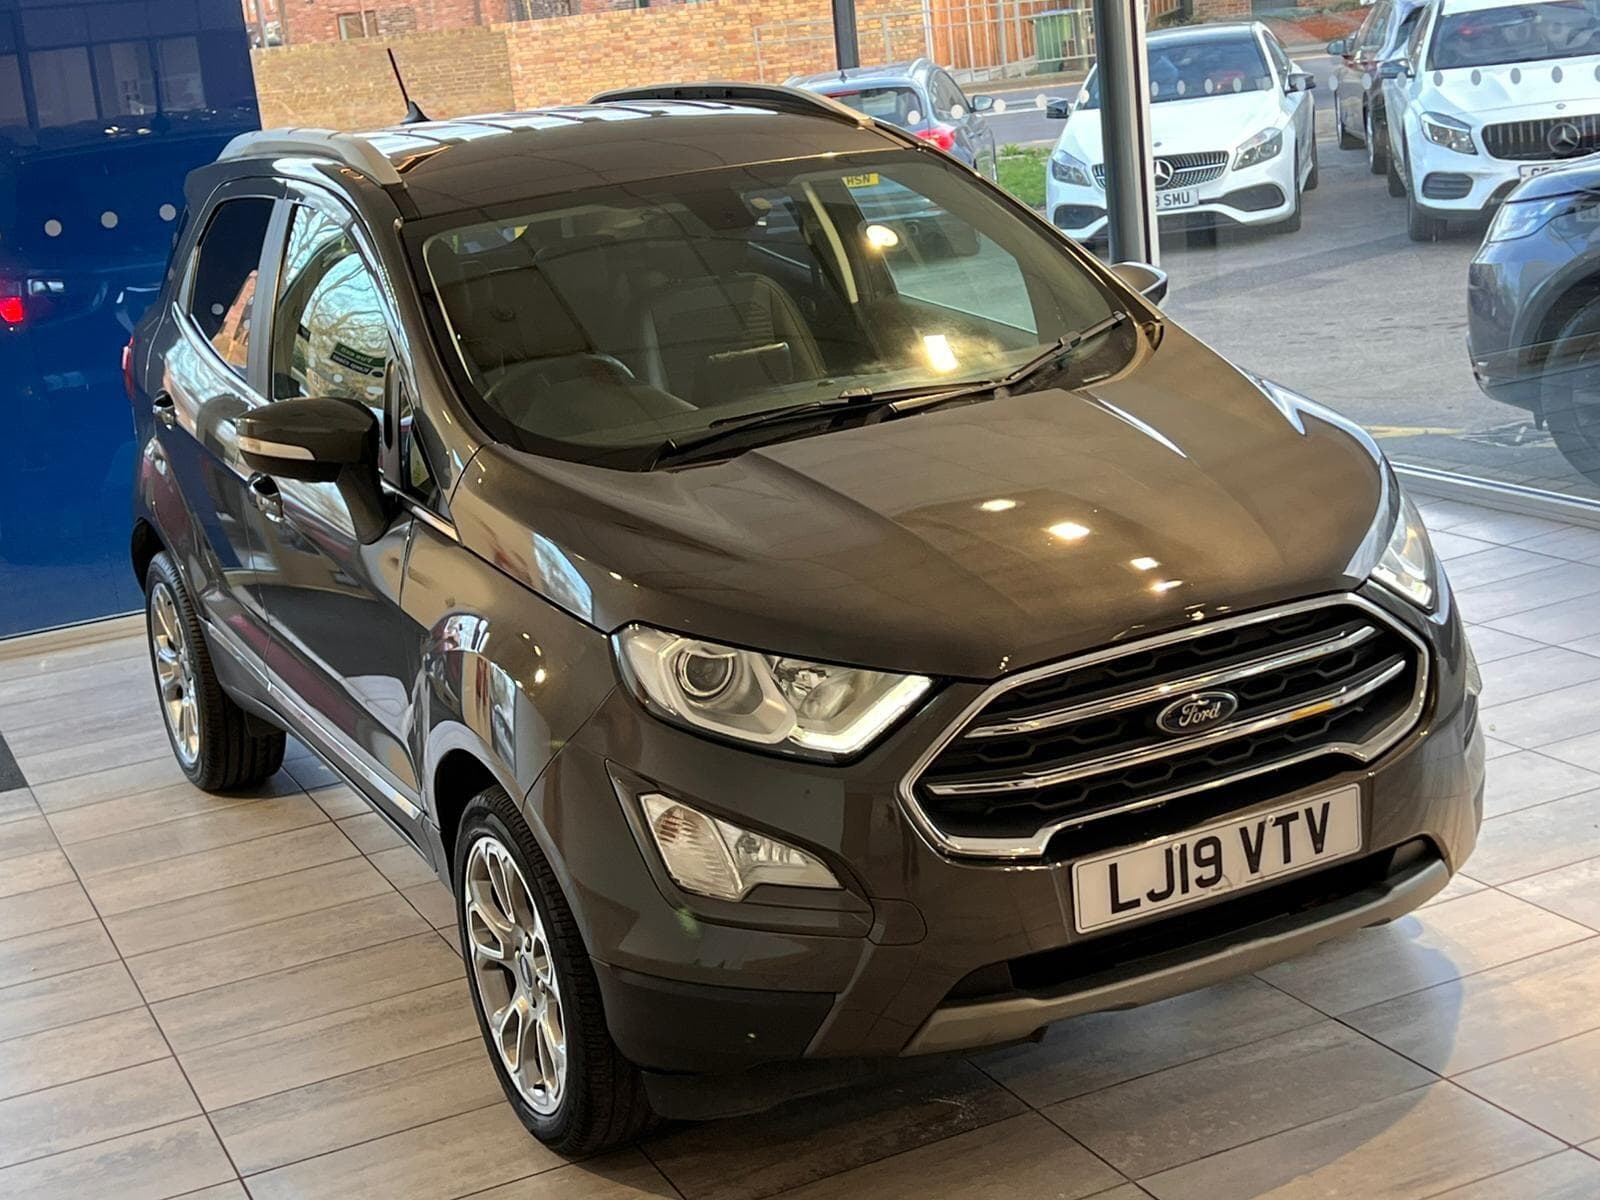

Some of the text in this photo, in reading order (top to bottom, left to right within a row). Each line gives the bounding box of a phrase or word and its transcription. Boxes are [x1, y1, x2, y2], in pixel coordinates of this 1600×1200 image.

[1163, 191, 1190, 206] SMU
[1179, 699, 1221, 727] Ford
[1108, 801, 1331, 914] LJ19 VTV
